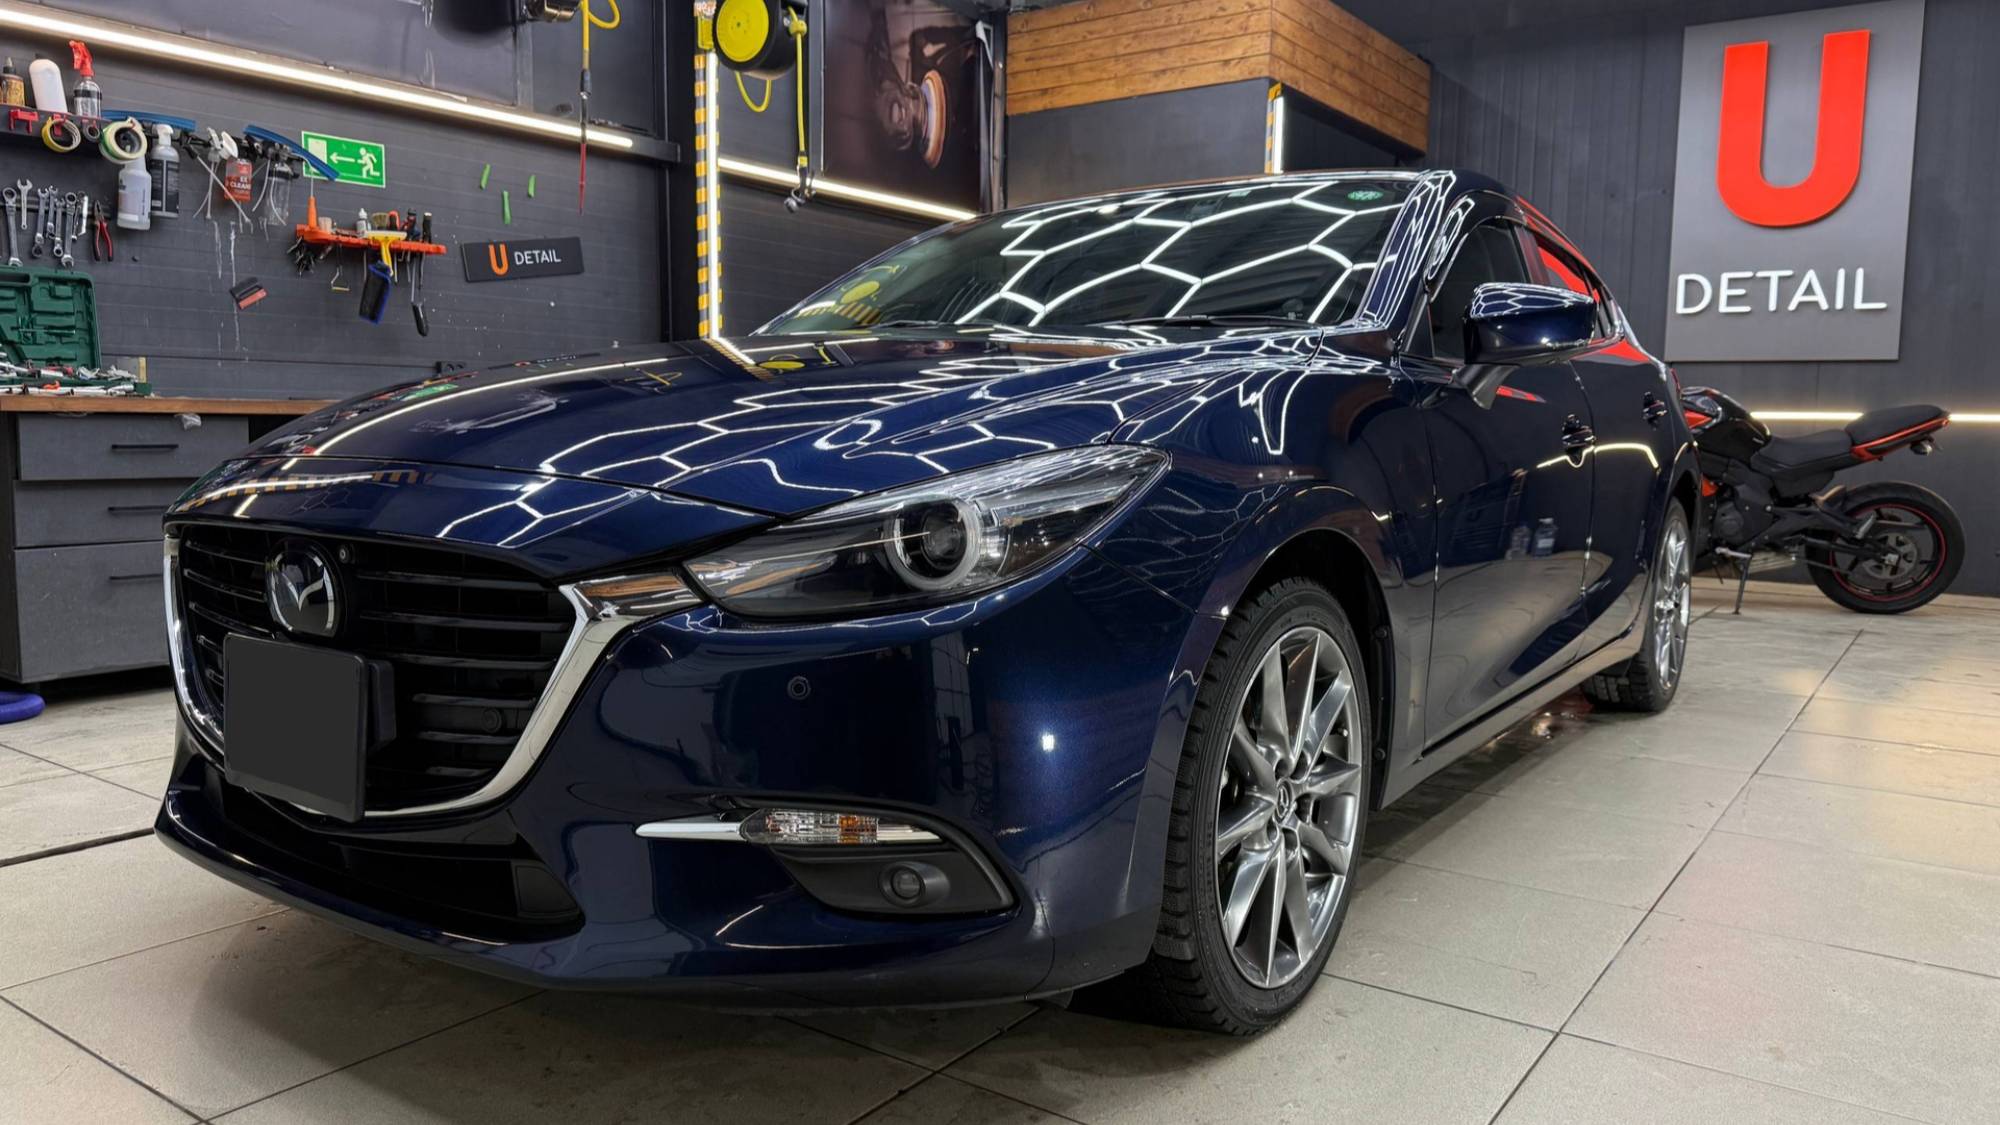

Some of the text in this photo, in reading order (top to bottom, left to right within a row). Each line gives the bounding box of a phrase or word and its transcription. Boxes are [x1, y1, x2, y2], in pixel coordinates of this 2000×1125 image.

[1716, 29, 1871, 227] U
[488, 243, 562, 276] U DETAIL
[1676, 267, 1887, 315] DETAIL
